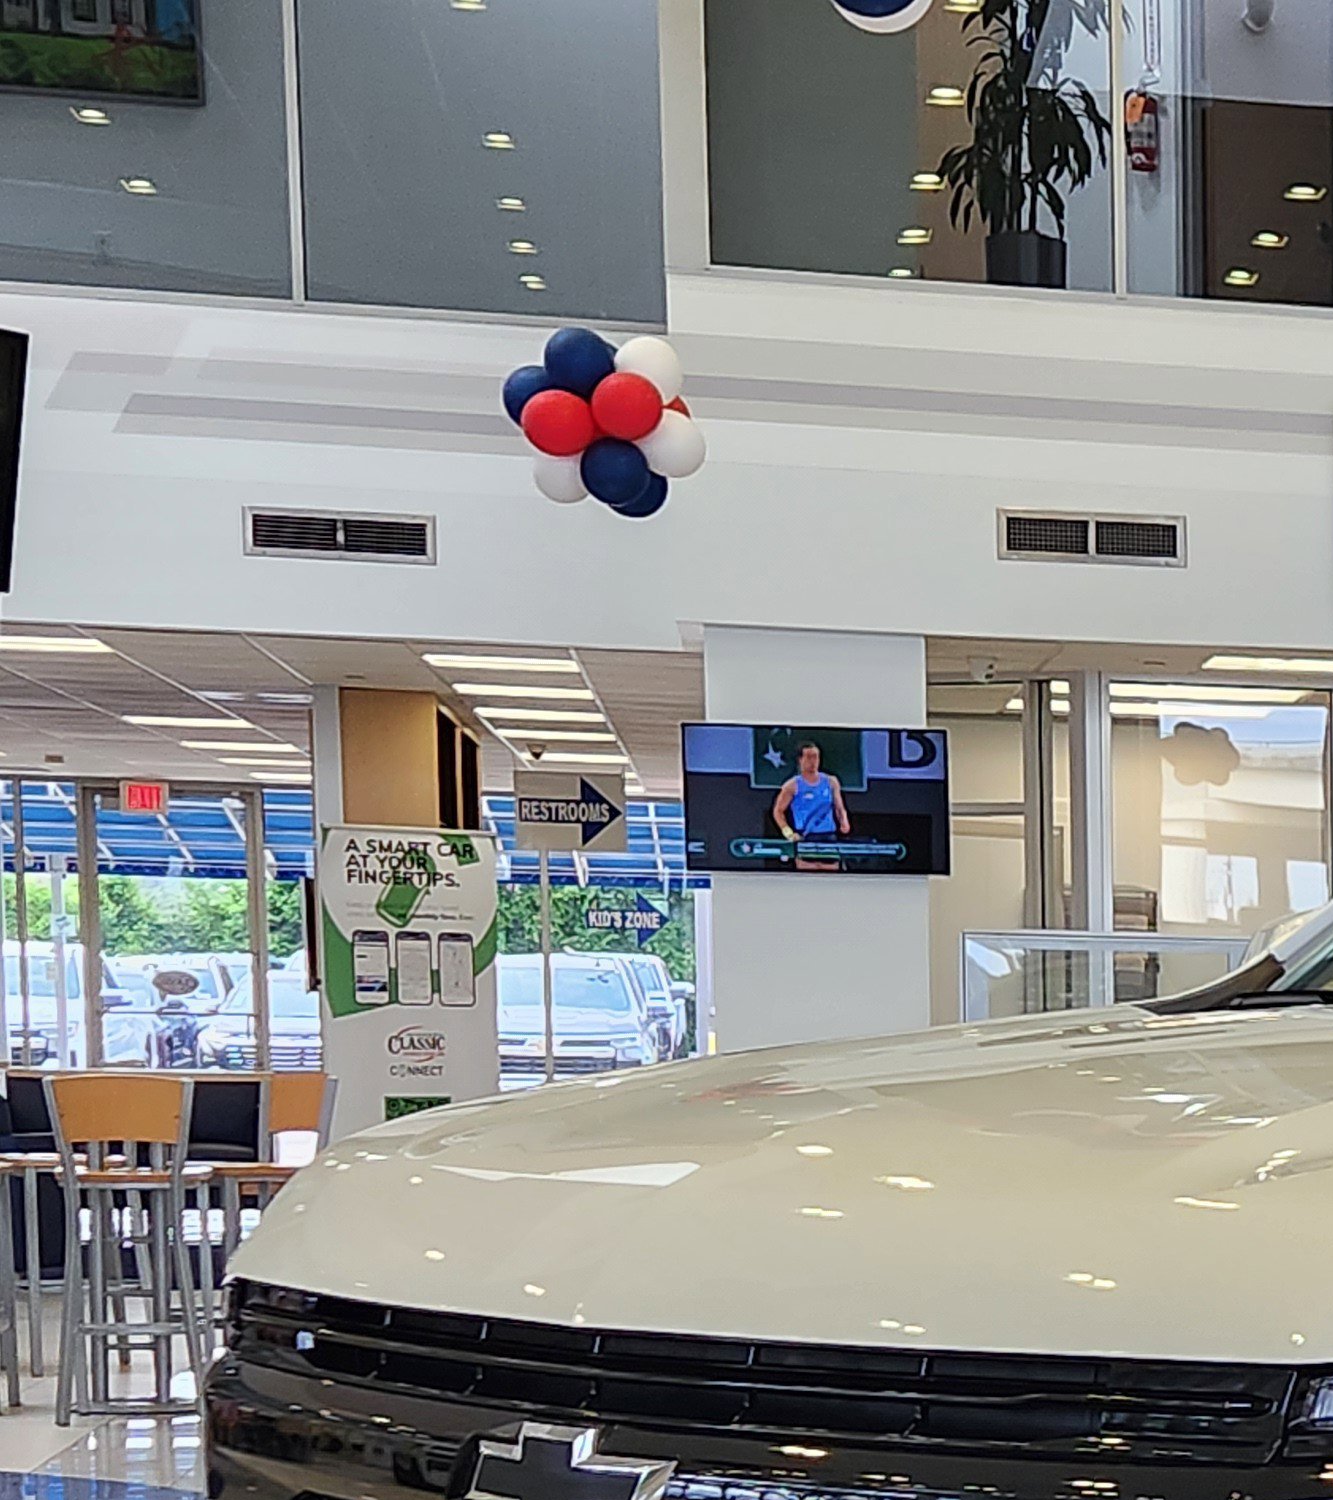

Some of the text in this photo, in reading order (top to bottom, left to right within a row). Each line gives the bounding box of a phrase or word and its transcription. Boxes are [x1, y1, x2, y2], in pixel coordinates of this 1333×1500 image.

[521, 802, 610, 823] RESTROOMS
[345, 838, 474, 859] A SMART CAR
[346, 854, 428, 870] AT YOUR
[346, 868, 461, 888] FINGERTIPS.
[588, 910, 661, 928] KID'S ZONE
